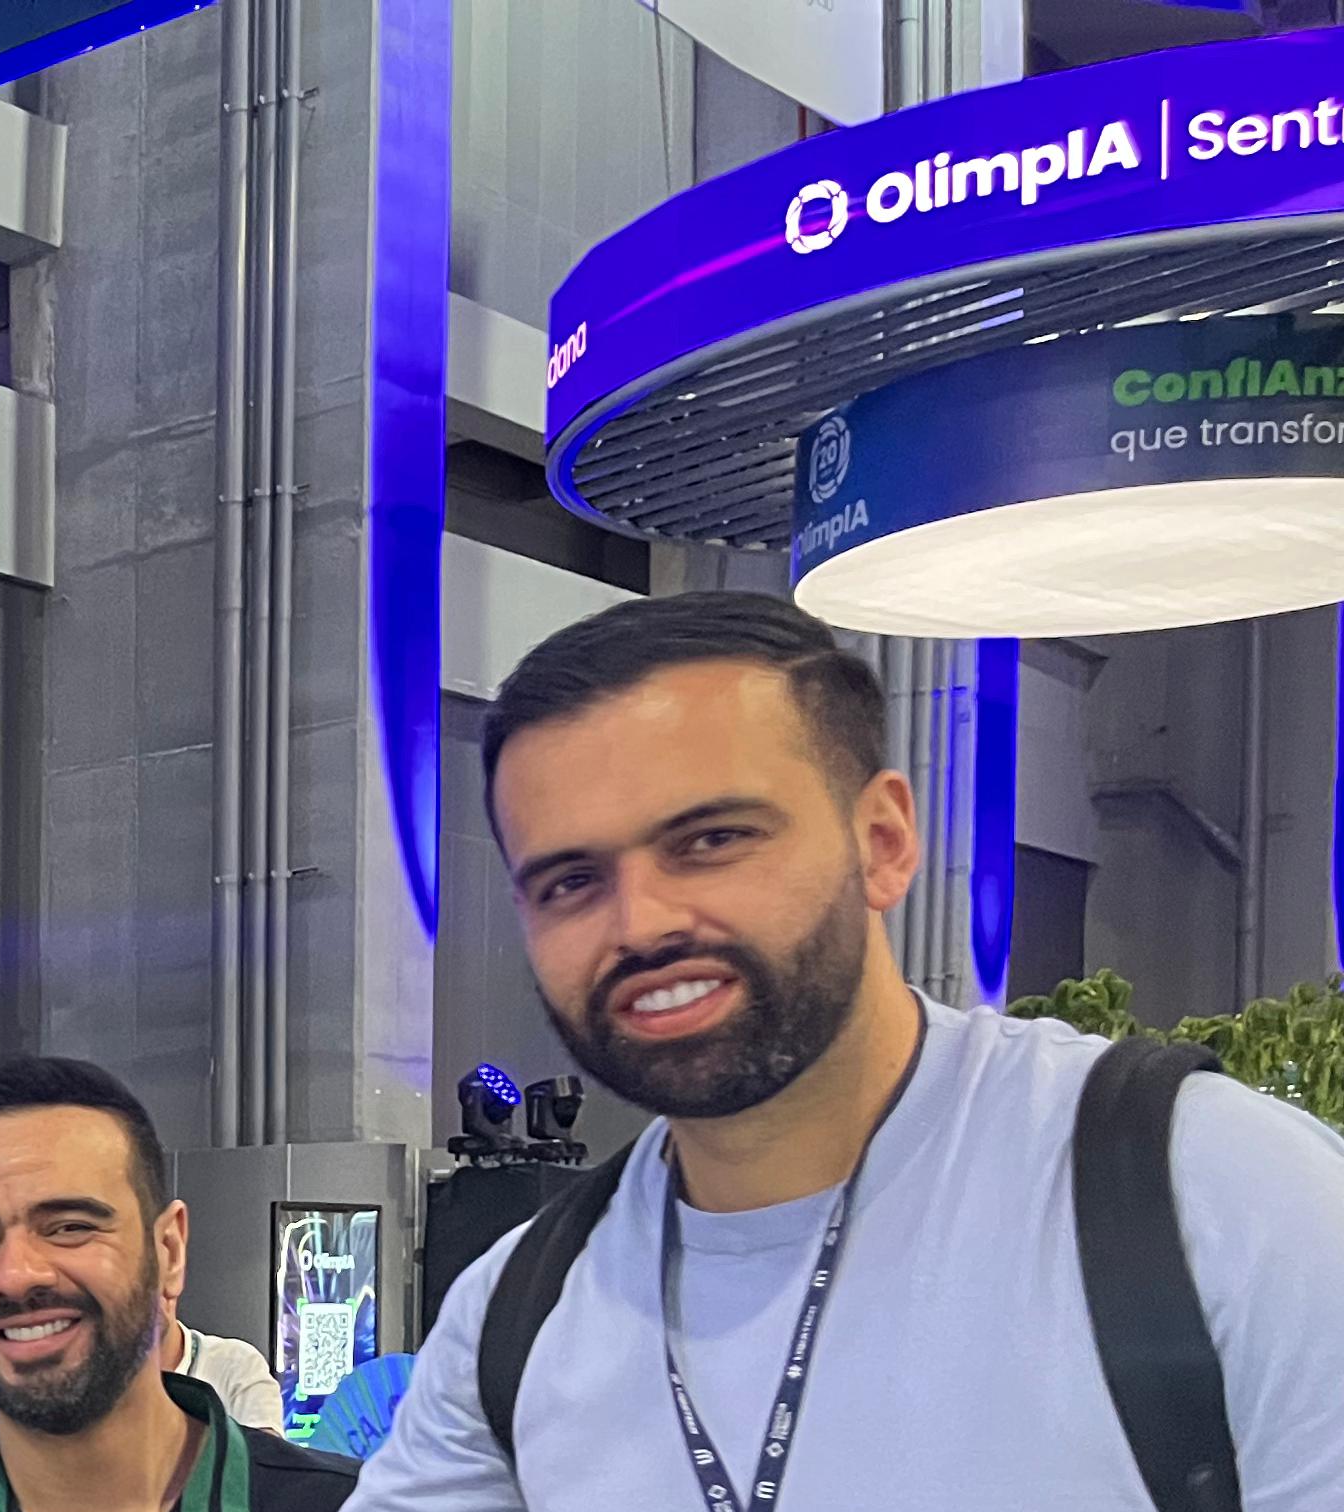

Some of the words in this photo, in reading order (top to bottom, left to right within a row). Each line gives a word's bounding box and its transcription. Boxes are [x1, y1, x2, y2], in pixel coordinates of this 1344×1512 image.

[865, 120, 1141, 223] OlimpIA
[1187, 97, 1344, 161] Sent
[1110, 425, 1189, 462] que
